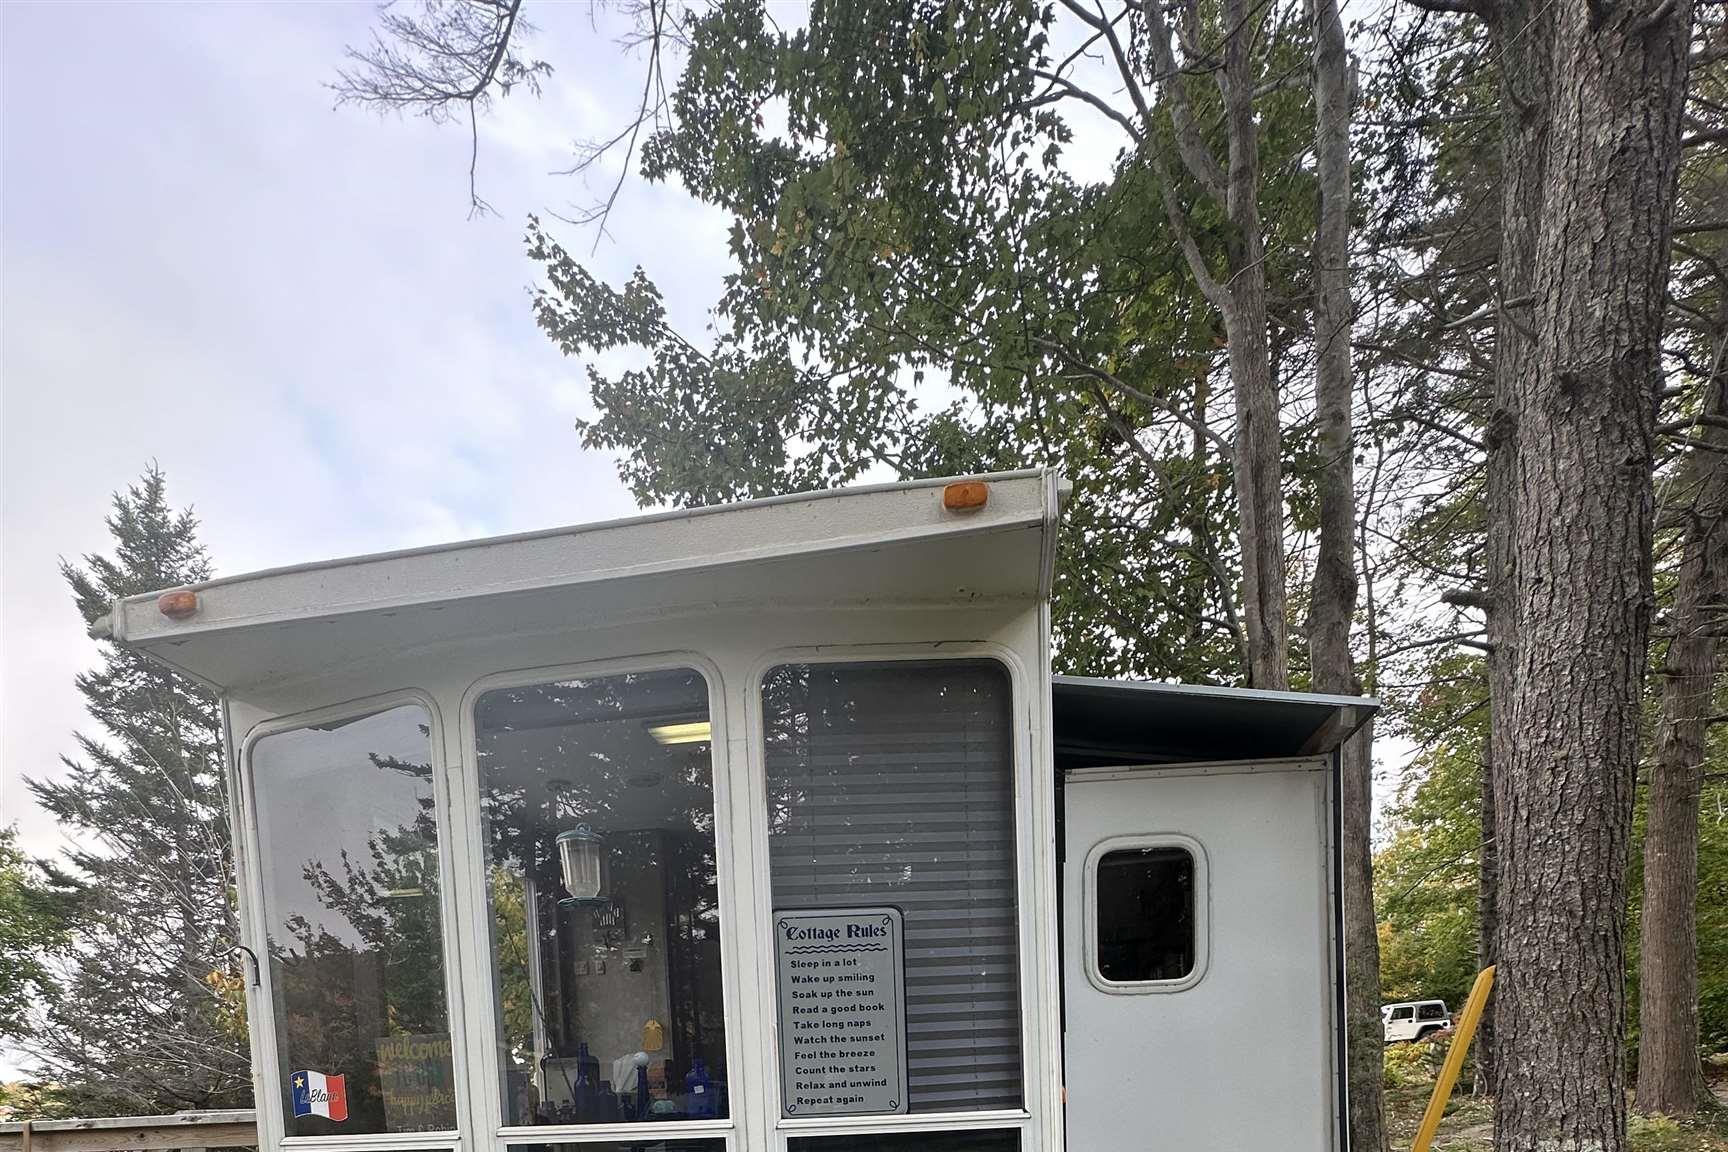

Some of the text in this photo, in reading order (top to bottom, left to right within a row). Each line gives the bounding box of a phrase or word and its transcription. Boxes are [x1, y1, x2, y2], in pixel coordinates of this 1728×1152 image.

[786, 924, 887, 942] Cottage Rules
[791, 960, 819, 969] Sleep
[822, 959, 831, 967] in
[791, 975, 820, 983] Wake
[838, 974, 875, 983] smiling
[792, 989, 874, 999] Soak up the sun
[793, 1006, 819, 1014] Read
[831, 1004, 856, 1015] good
[859, 1003, 885, 1011] book
[793, 1020, 872, 1029] Take long naps
[794, 1033, 885, 1045] Watch the sunset
[795, 1052, 816, 1060] Feel
[839, 1050, 875, 1058] breeze
[796, 1067, 826, 1075] Count
[829, 1066, 845, 1074] the
[796, 1079, 887, 1090] Relax and unwind
[797, 1095, 864, 1105] Repeat again
